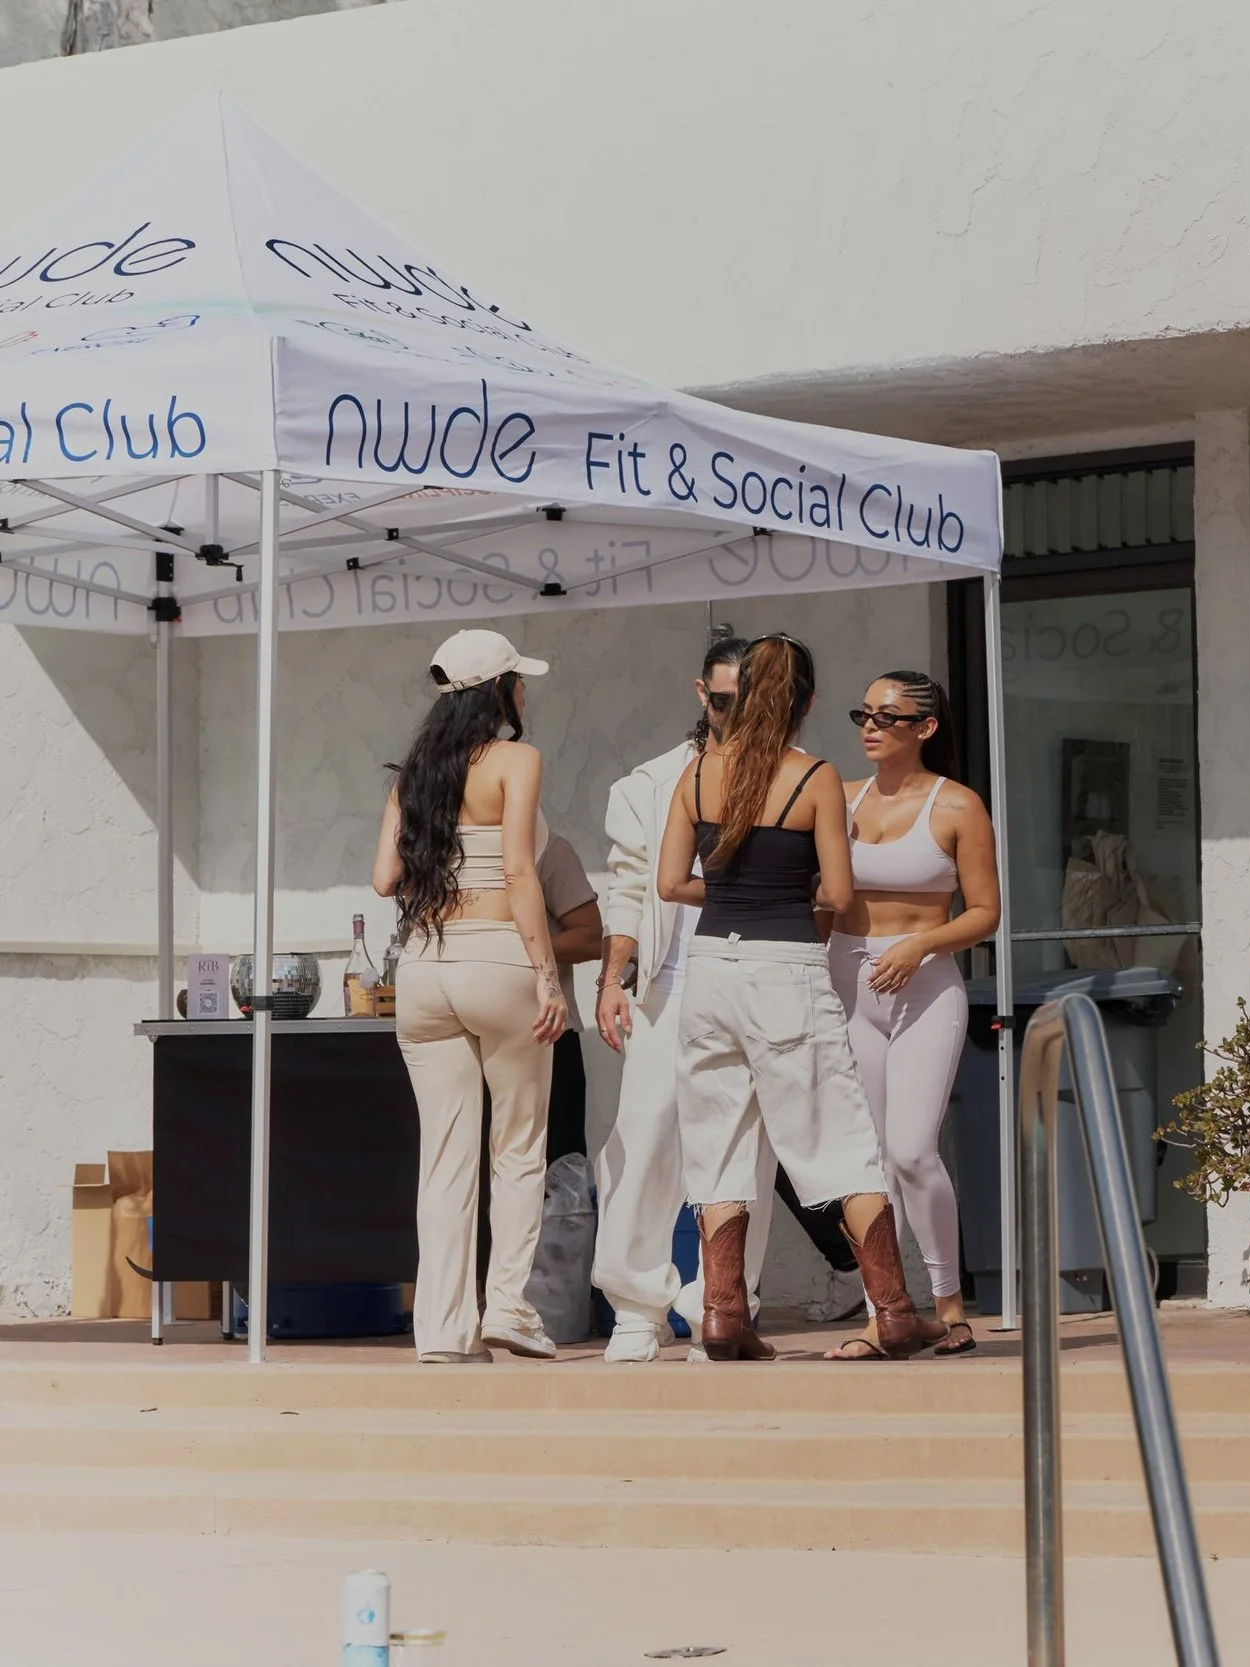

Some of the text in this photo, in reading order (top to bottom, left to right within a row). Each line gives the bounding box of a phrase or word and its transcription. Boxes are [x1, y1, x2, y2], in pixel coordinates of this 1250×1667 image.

[45, 288, 134, 308] Club
[55, 395, 206, 461] Club
[326, 378, 964, 554] nwde Fit & Social Club
